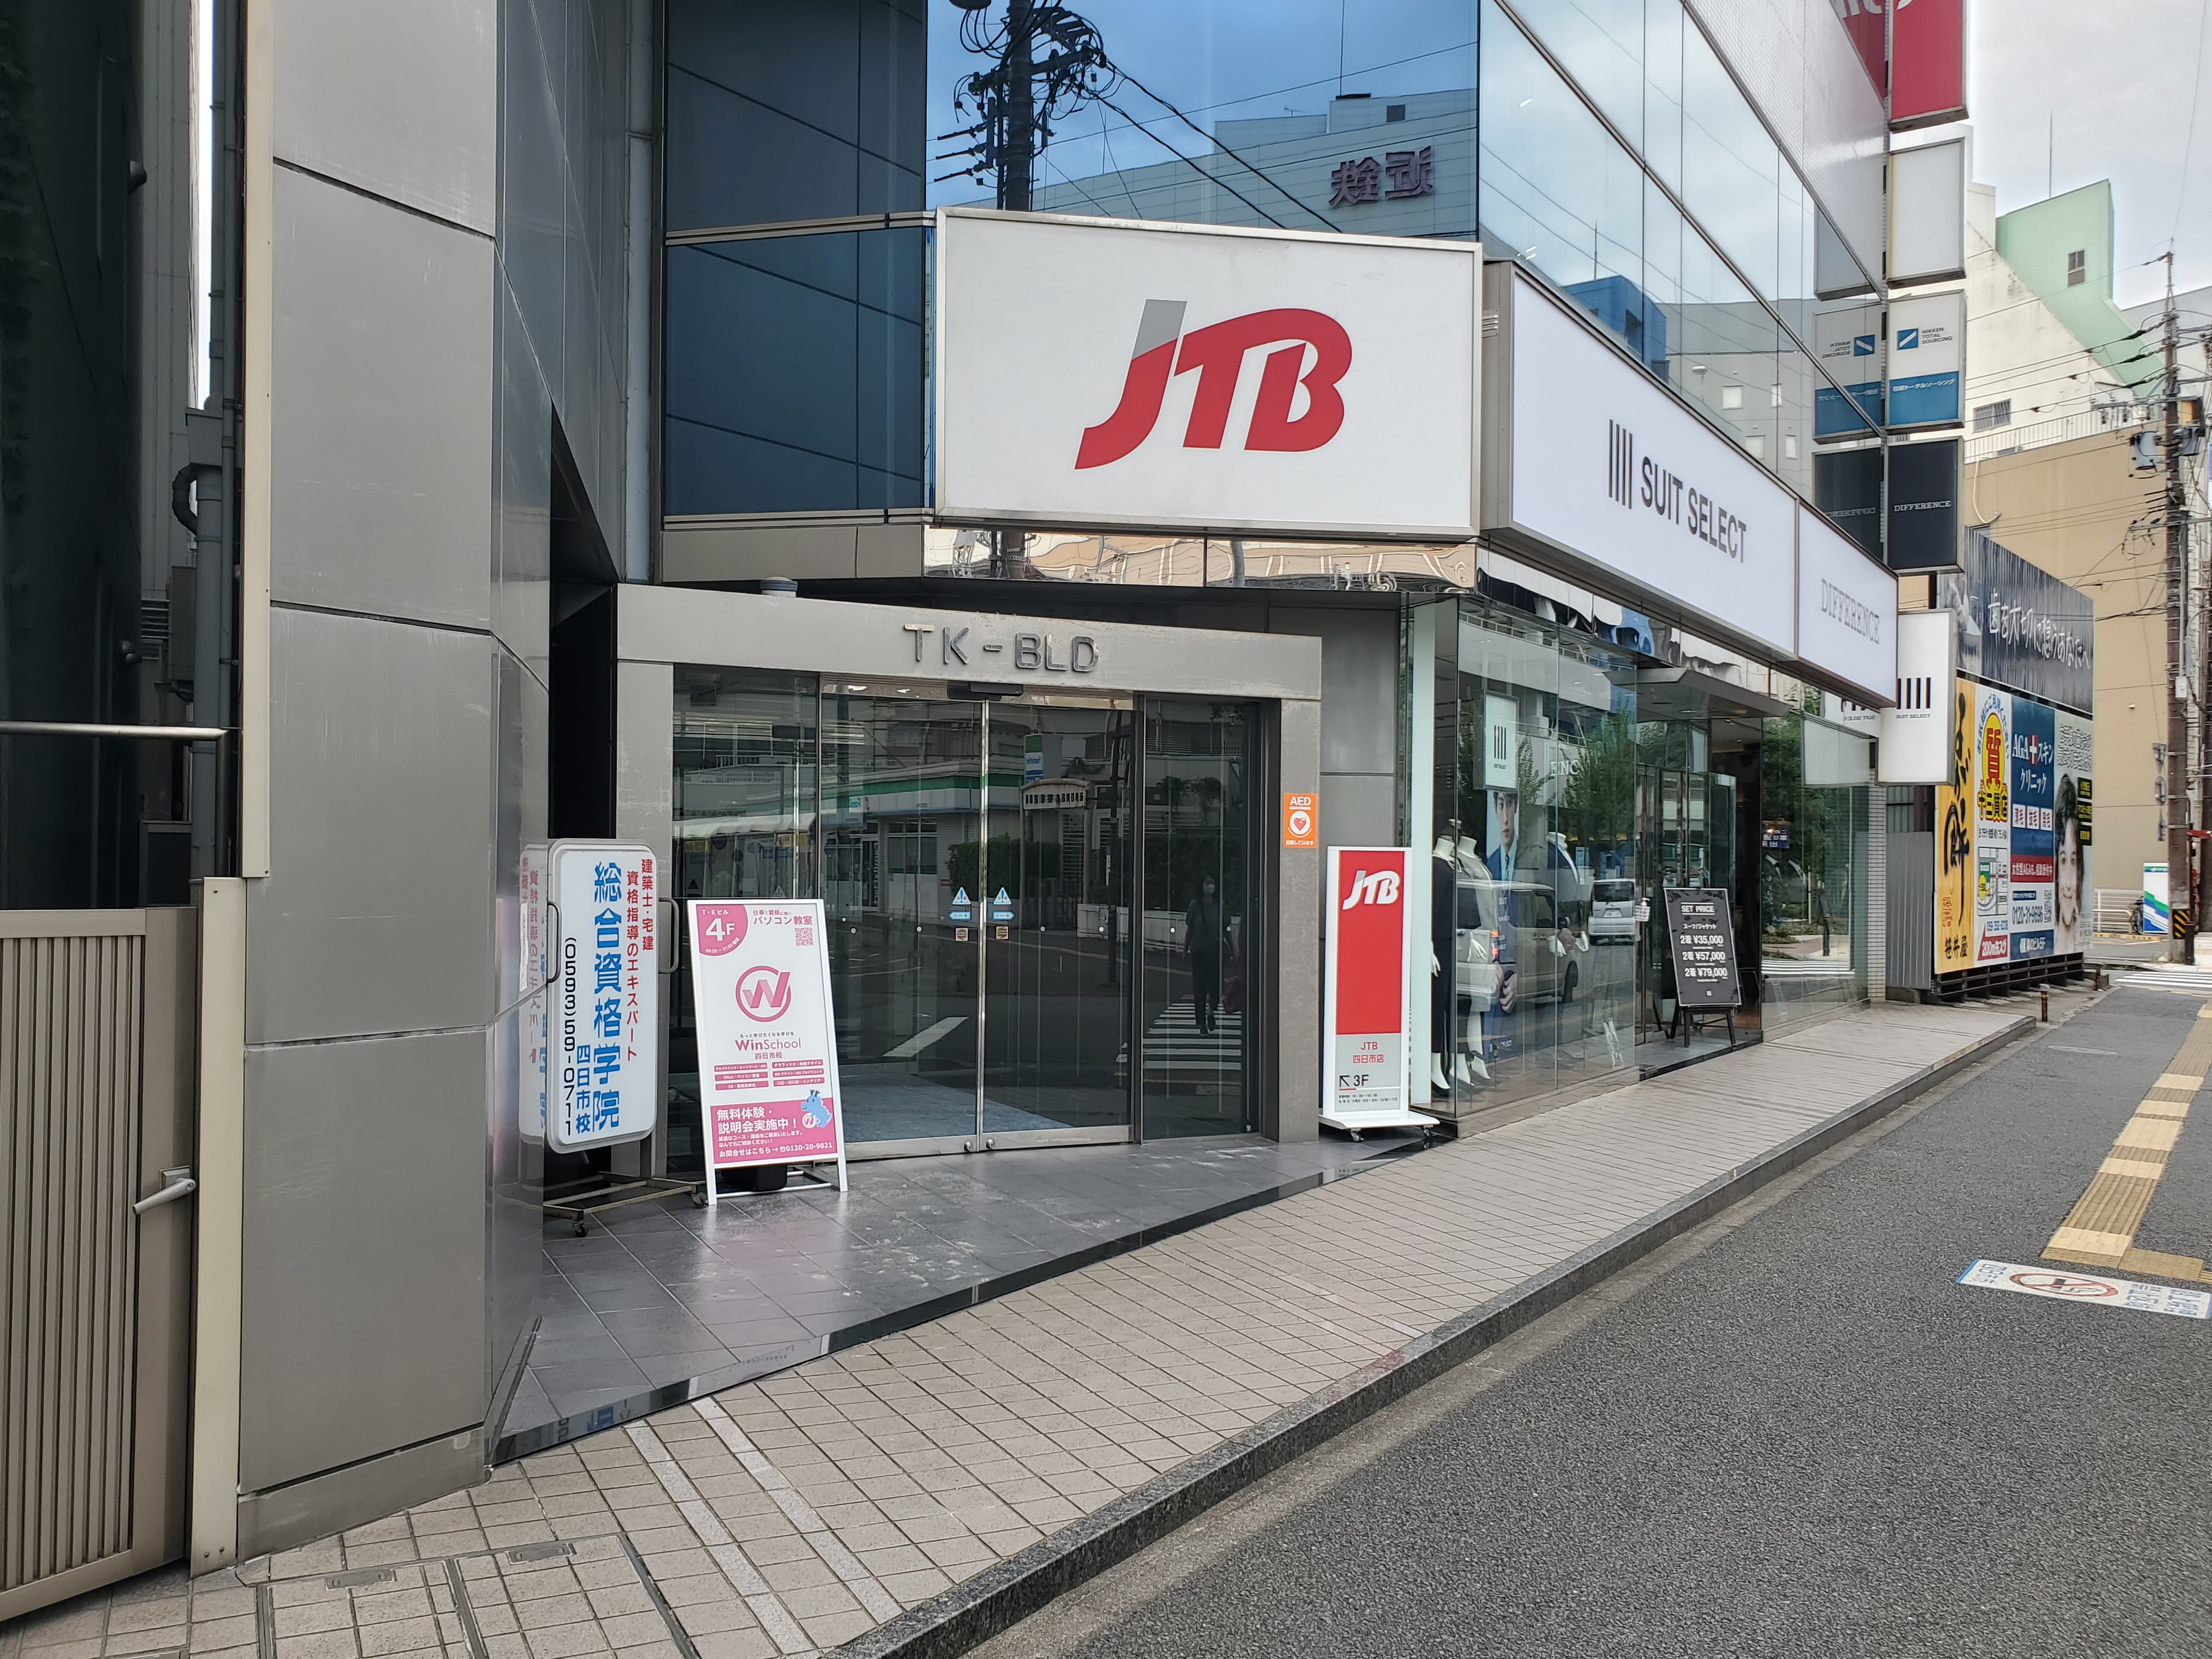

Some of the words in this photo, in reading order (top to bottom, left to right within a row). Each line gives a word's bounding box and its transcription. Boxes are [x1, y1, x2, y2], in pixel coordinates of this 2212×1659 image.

[1922, 336, 1953, 345] SOURCING
[1074, 299, 1352, 470] JTB
[1893, 378, 1955, 392] 日研トータルソーシング
[1641, 456, 1683, 525] SUIT
[1688, 487, 1746, 563] SELECT
[1894, 500, 1951, 512] DIFFERENCE
[1821, 578, 1880, 645] DIFFERENCE
[904, 623, 1099, 673] TK-BLD
[2012, 733, 2029, 760] AGA
[2038, 741, 2053, 765] スキン
[2019, 768, 2047, 795] クリニック
[1289, 796, 1311, 806] AED
[1342, 870, 1401, 910] JTB
[641, 859, 654, 951] 建築士・宅建
[706, 918, 735, 941] 4F
[753, 916, 813, 926] パソコン教室
[1680, 935, 1691, 944] 2着
[1693, 935, 1724, 945] ¥35,000
[627, 871, 639, 1061] 資格指導のエキスパート
[1682, 951, 1694, 960] 2着
[1695, 951, 1725, 962] ¥57,000
[1684, 968, 1696, 977] 2着
[1697, 968, 1728, 978] ¥79,000
[592, 861, 622, 1132] 総合資格学院
[564, 937, 577, 1136] (0593)59-0711
[735, 1037, 802, 1051] WinSchool
[1361, 1042, 1378, 1050] JTB
[1353, 1054, 1384, 1063] 四日市店
[576, 1045, 591, 1135] 四日市校
[1353, 1074, 1369, 1086] 3F
